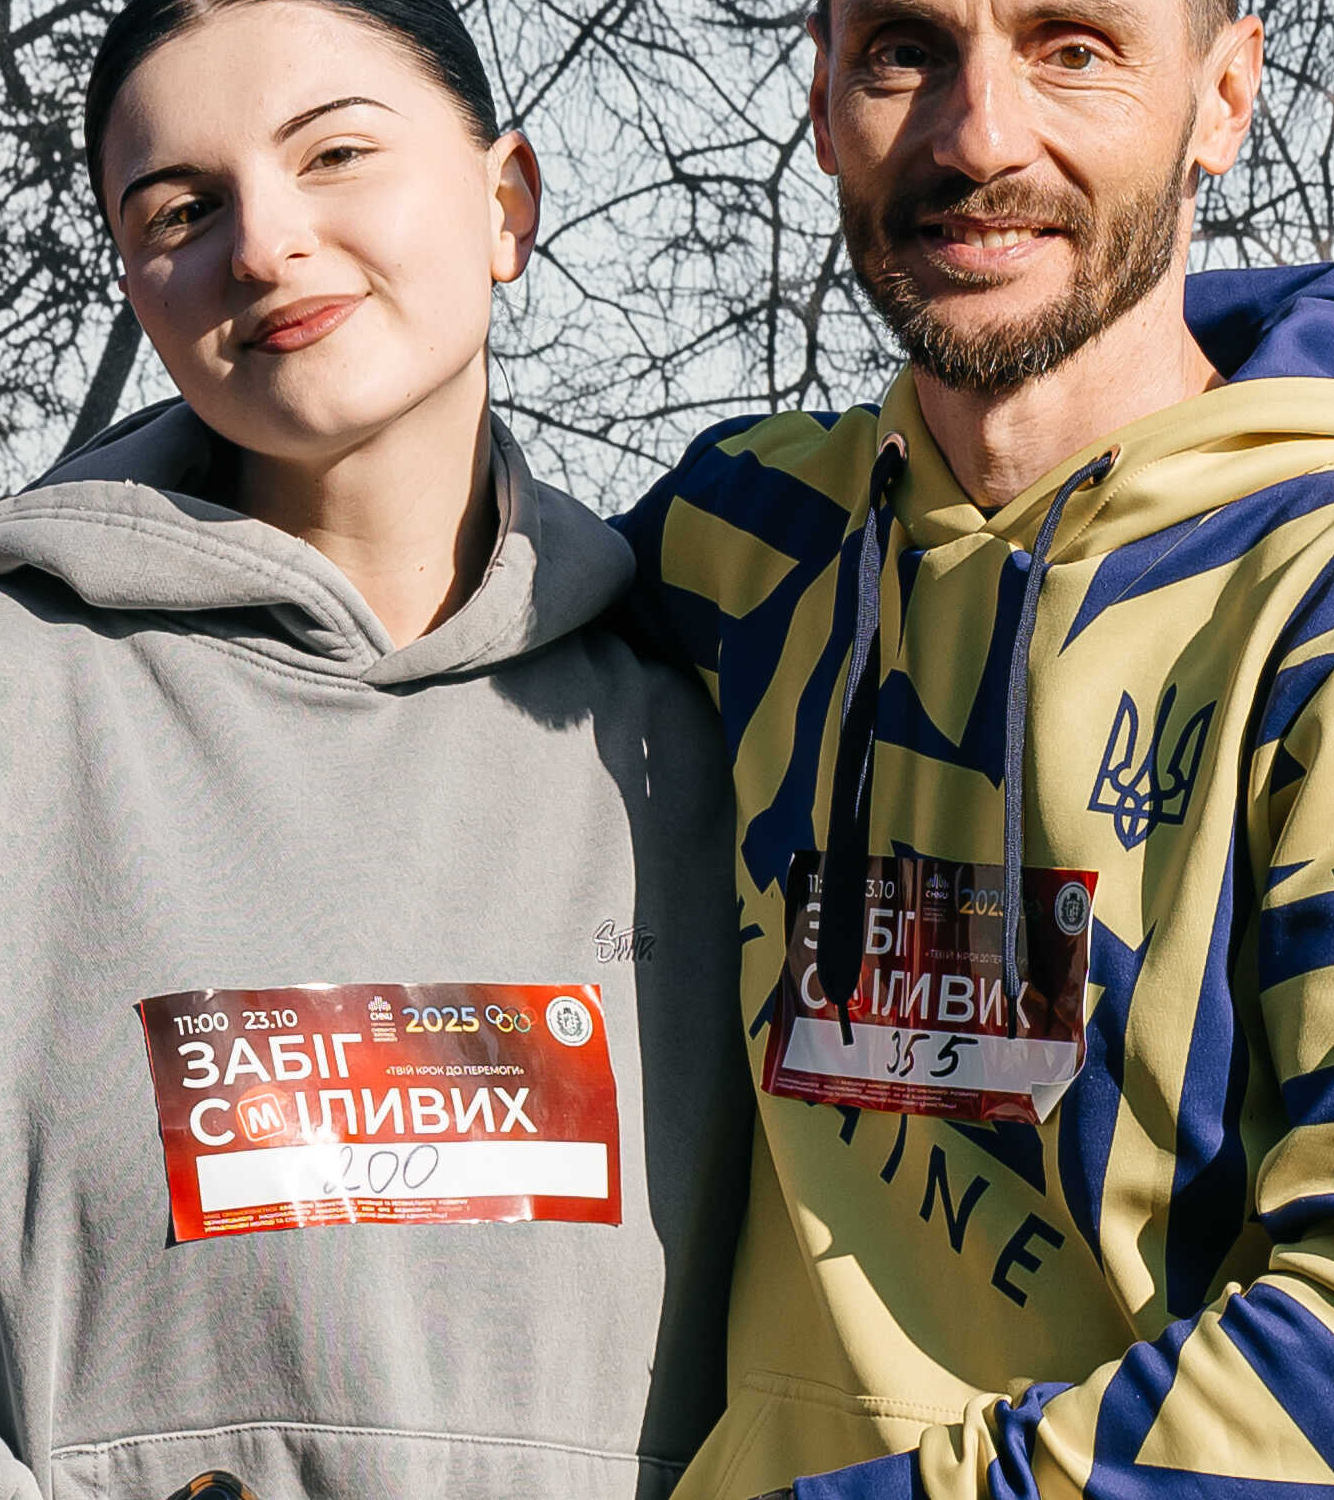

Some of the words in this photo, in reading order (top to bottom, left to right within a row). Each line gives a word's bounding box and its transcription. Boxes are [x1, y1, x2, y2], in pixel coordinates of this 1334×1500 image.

[865, 879, 895, 899] 3.10
[174, 1011, 228, 1035] 11:00
[242, 1008, 298, 1031] 23.10
[370, 1010, 393, 1021] CHNU
[403, 1006, 481, 1034] 2025
[177, 1033, 362, 1089] ЗАБІГ
[416, 1065, 444, 1076] КРОК
[323, 1144, 440, 1195] 200
